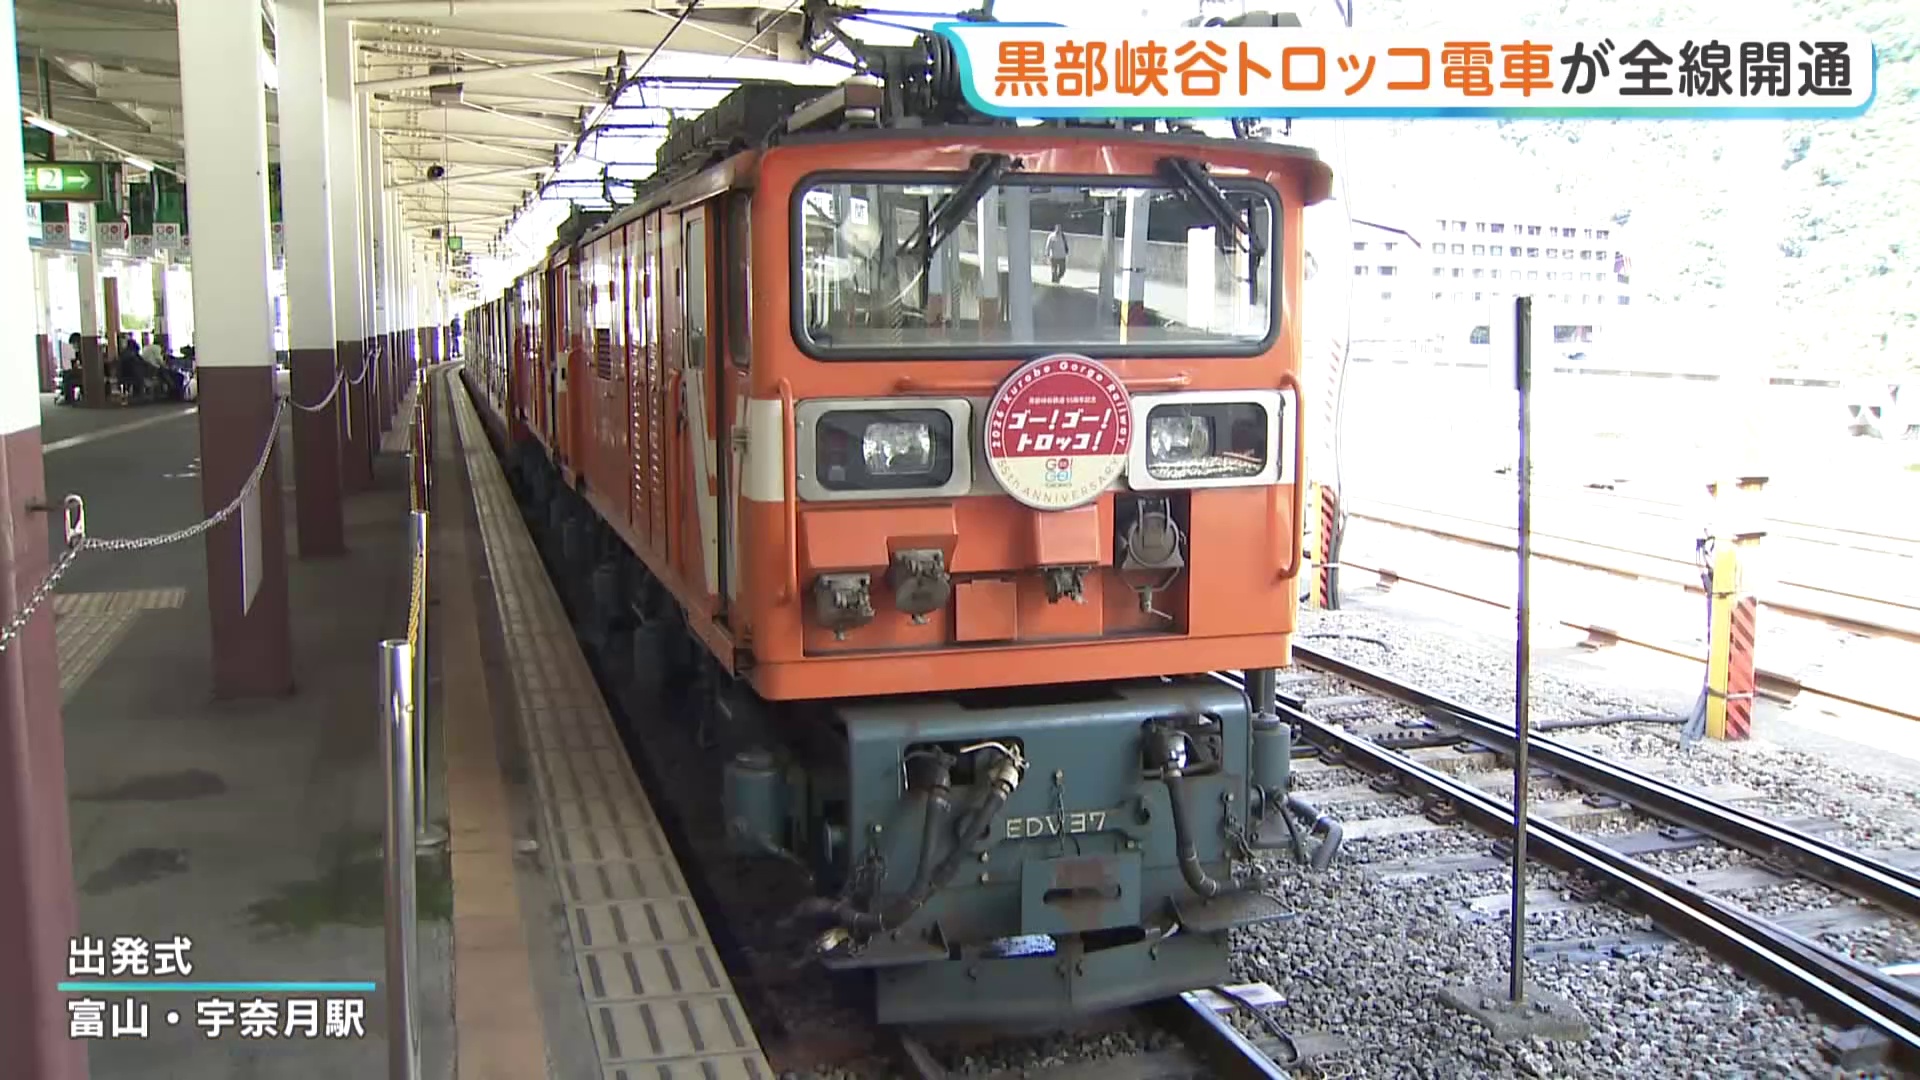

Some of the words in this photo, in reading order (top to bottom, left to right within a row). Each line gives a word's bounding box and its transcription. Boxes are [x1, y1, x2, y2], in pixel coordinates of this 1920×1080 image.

[1003, 365, 1051, 404] Kurobe
[1059, 361, 1104, 381] Gorge
[1106, 383, 1127, 446] Railway
[1017, 430, 1102, 452] トロッコ！
